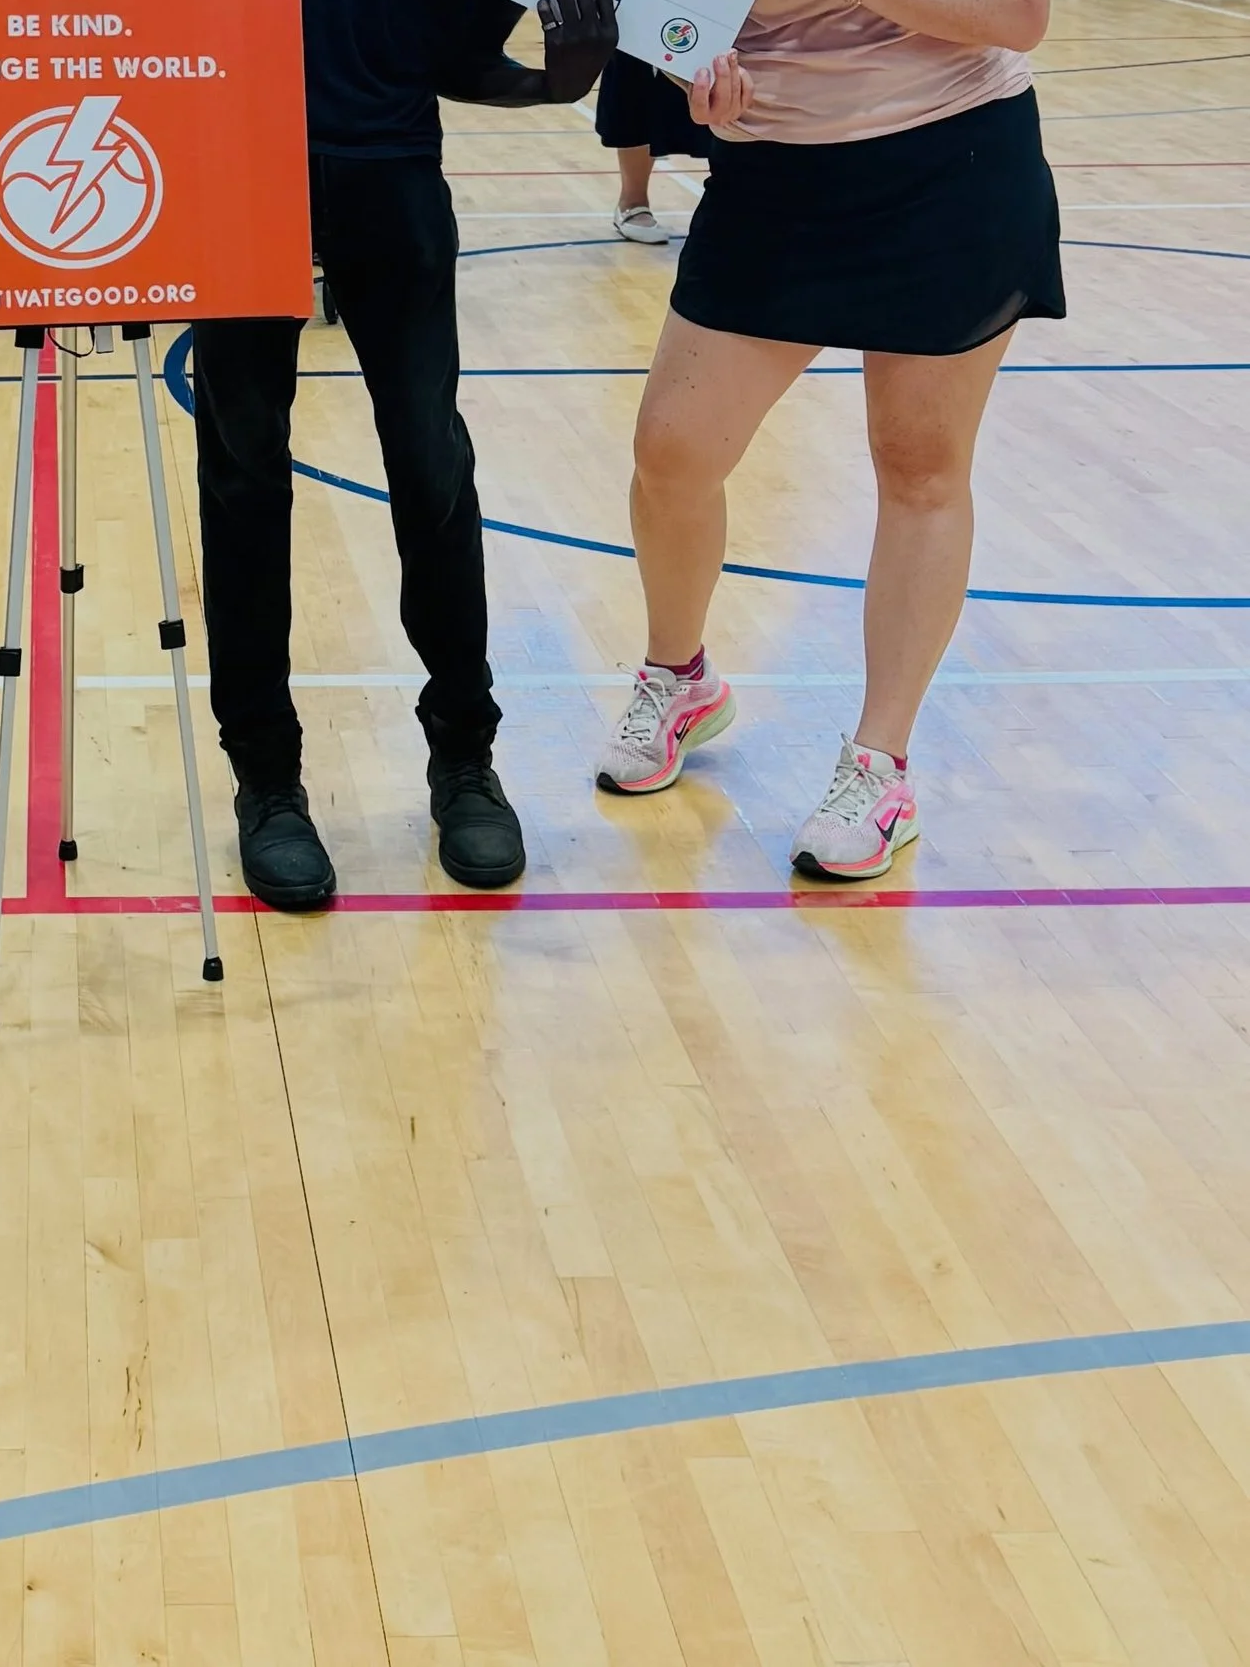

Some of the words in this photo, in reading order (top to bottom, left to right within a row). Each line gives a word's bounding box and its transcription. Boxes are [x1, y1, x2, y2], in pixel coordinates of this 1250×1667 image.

[8, 15, 40, 36] BE
[51, 14, 133, 36] KIND.
[51, 58, 102, 79] THE
[114, 56, 226, 79] WORLD.
